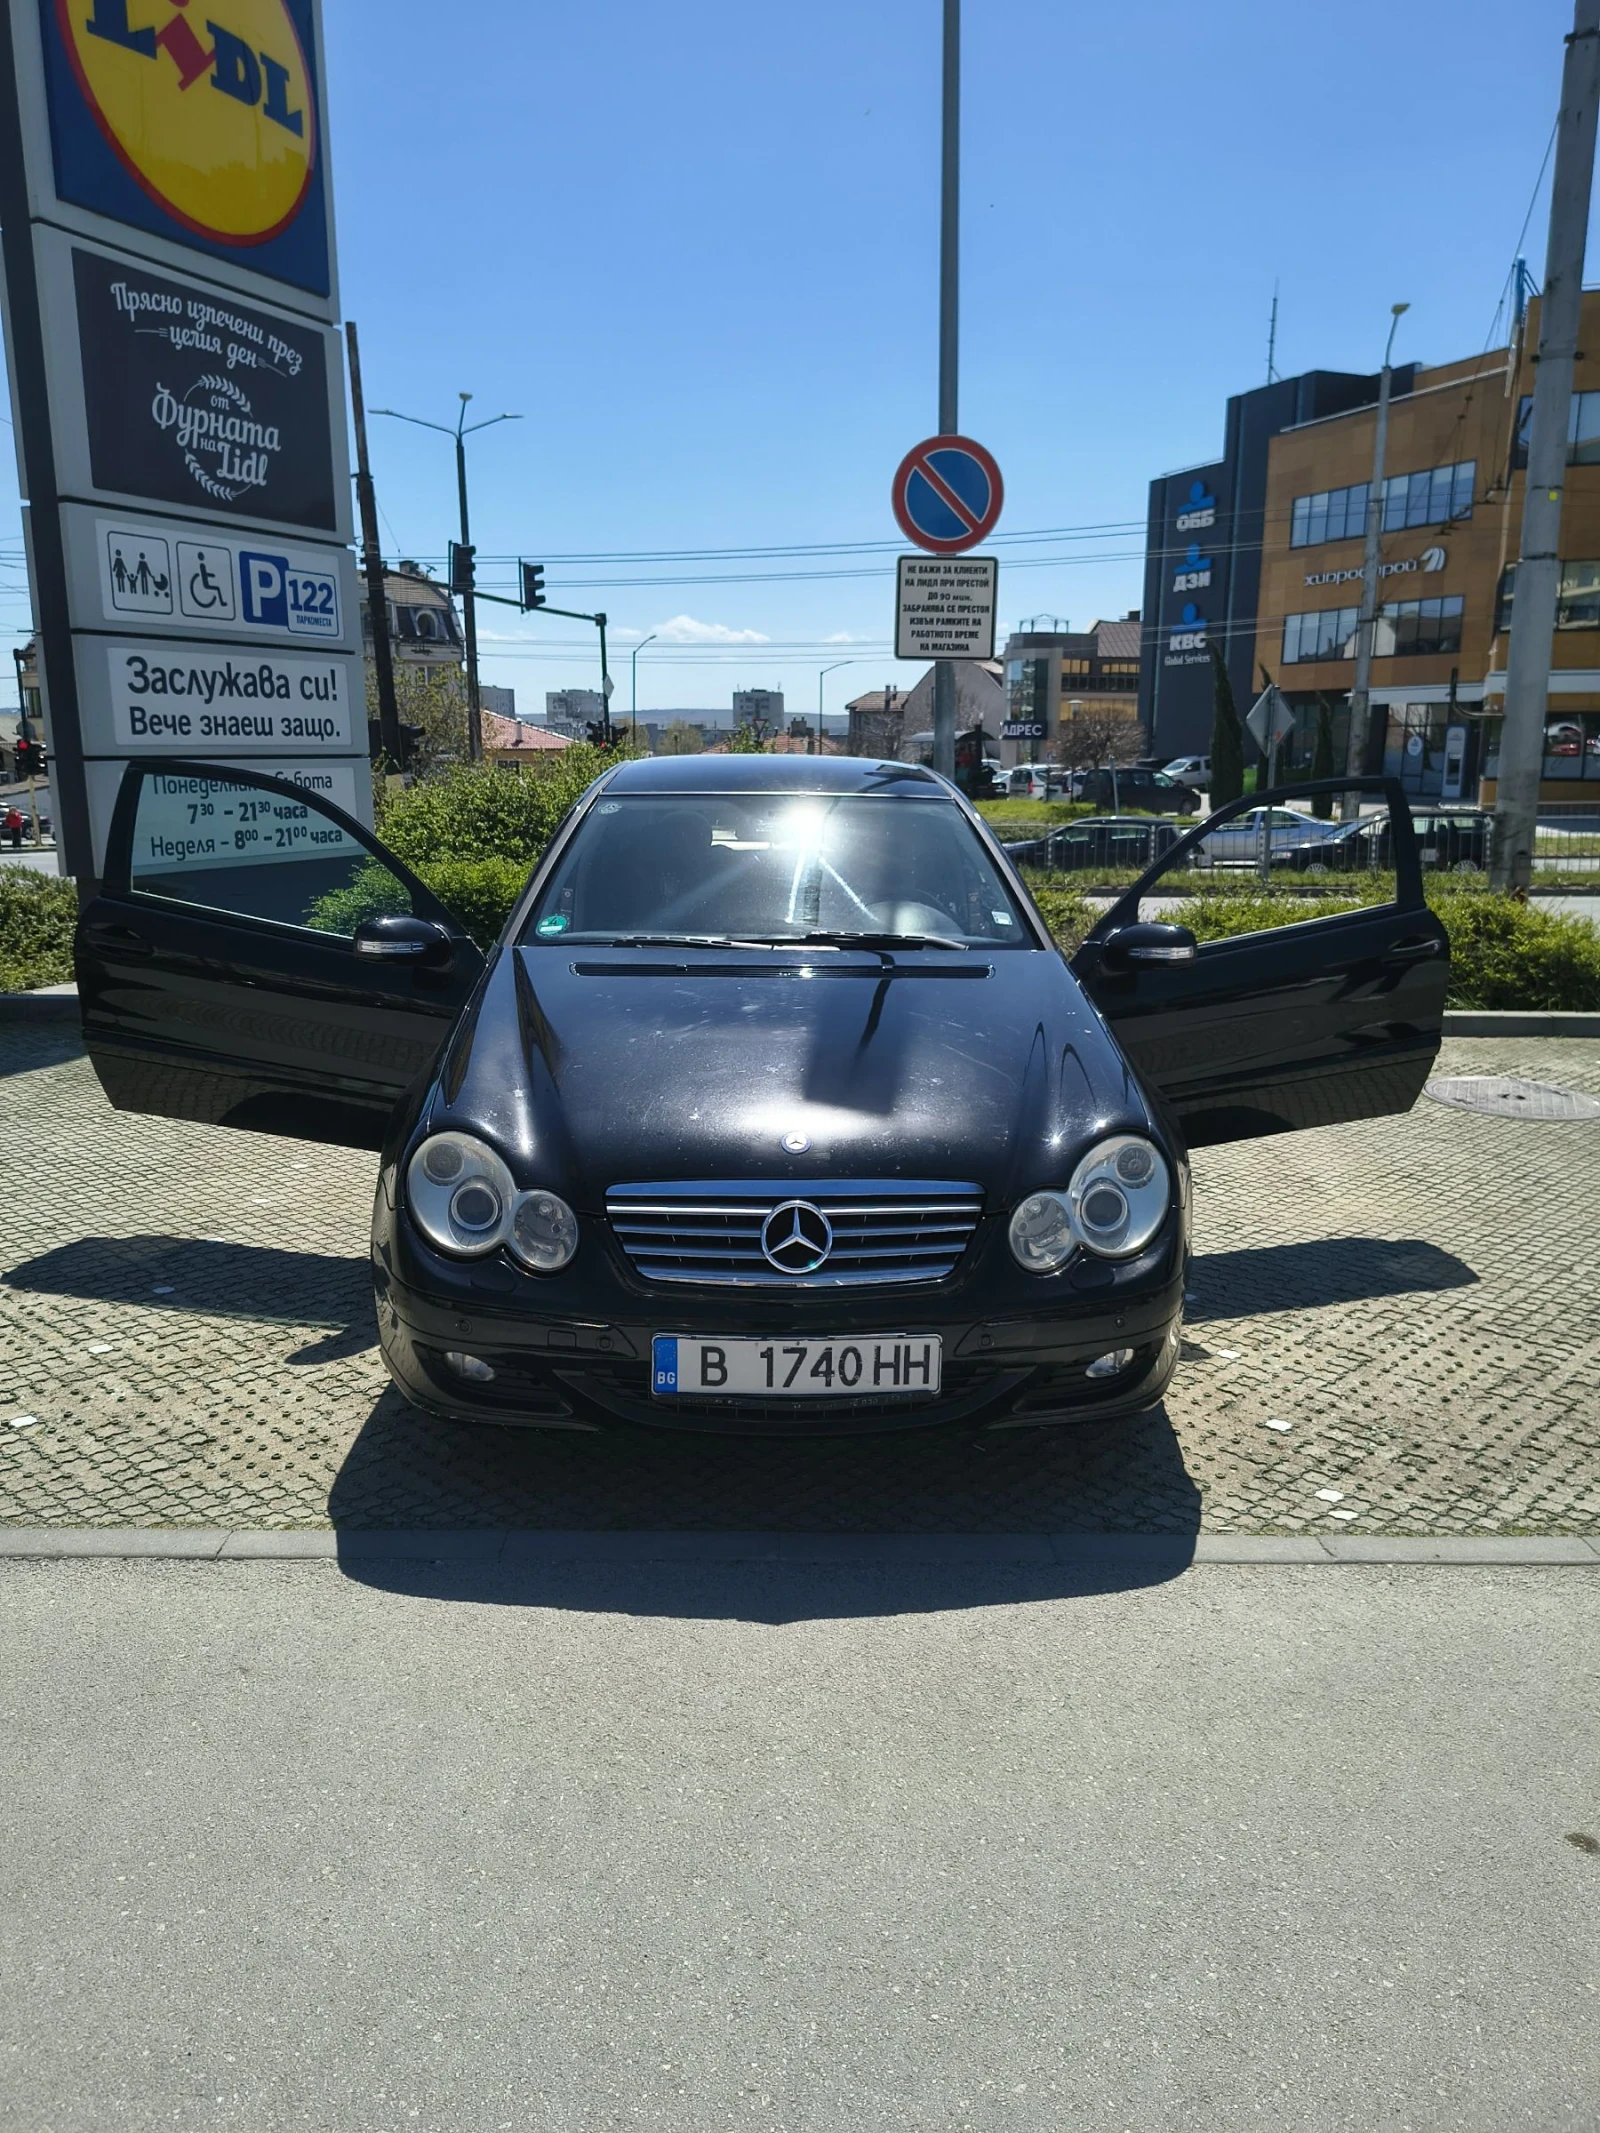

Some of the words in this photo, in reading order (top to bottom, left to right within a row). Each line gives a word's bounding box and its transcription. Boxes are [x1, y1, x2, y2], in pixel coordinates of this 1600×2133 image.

[110, 282, 182, 322] Прясно
[187, 300, 264, 345] изпечени
[267, 333, 303, 376] през
[169, 326, 223, 355] целия
[226, 342, 258, 369] ден
[210, 395, 230, 411] от
[152, 382, 281, 452] Фурната
[200, 438, 217, 452] на
[216, 441, 268, 486] Lidl
[907, 566, 917, 574] НЕ
[918, 566, 941, 575] ВАЖИ
[942, 566, 952, 575] ЗА
[954, 566, 988, 575] КЛИЕНТИ
[248, 559, 281, 618] P
[904, 579, 915, 587] НА
[916, 579, 938, 588] ЛИДЛ
[939, 579, 955, 587] ПРИ
[956, 578, 989, 588] ПРЕСТОЙ
[1172, 571, 1212, 593] ДЗИ
[288, 578, 334, 615] 122
[927, 592, 938, 601] ДО
[940, 593, 951, 601] 90
[902, 604, 945, 613] ЗАБРАНЯВА
[946, 605, 956, 613] СЕ
[296, 615, 332, 627] ПАРКОМЕСТА
[909, 617, 934, 626] ИЗВЪН
[935, 617, 970, 626] РАМКИТЕ
[971, 618, 982, 626] НА
[910, 630, 953, 639] РАБОТНОТО
[954, 630, 979, 639] ВРЕМЕ
[1169, 631, 1208, 651] KBC
[919, 643, 930, 652] НА
[931, 643, 970, 652] МАГАЗИНА
[126, 656, 291, 704] Заслужава
[300, 669, 338, 701] си!
[129, 706, 192, 736] Вече
[199, 714, 274, 737] знаеш
[281, 717, 341, 741] защо.
[1002, 724, 1042, 736] АДРЕС
[273, 805, 308, 820] часа
[151, 836, 216, 861] Неделя
[310, 829, 343, 844] часа
[700, 1346, 728, 1387] B
[760, 1346, 863, 1388] 1740
[873, 1344, 931, 1386] HH
[657, 1372, 675, 1385] BG
